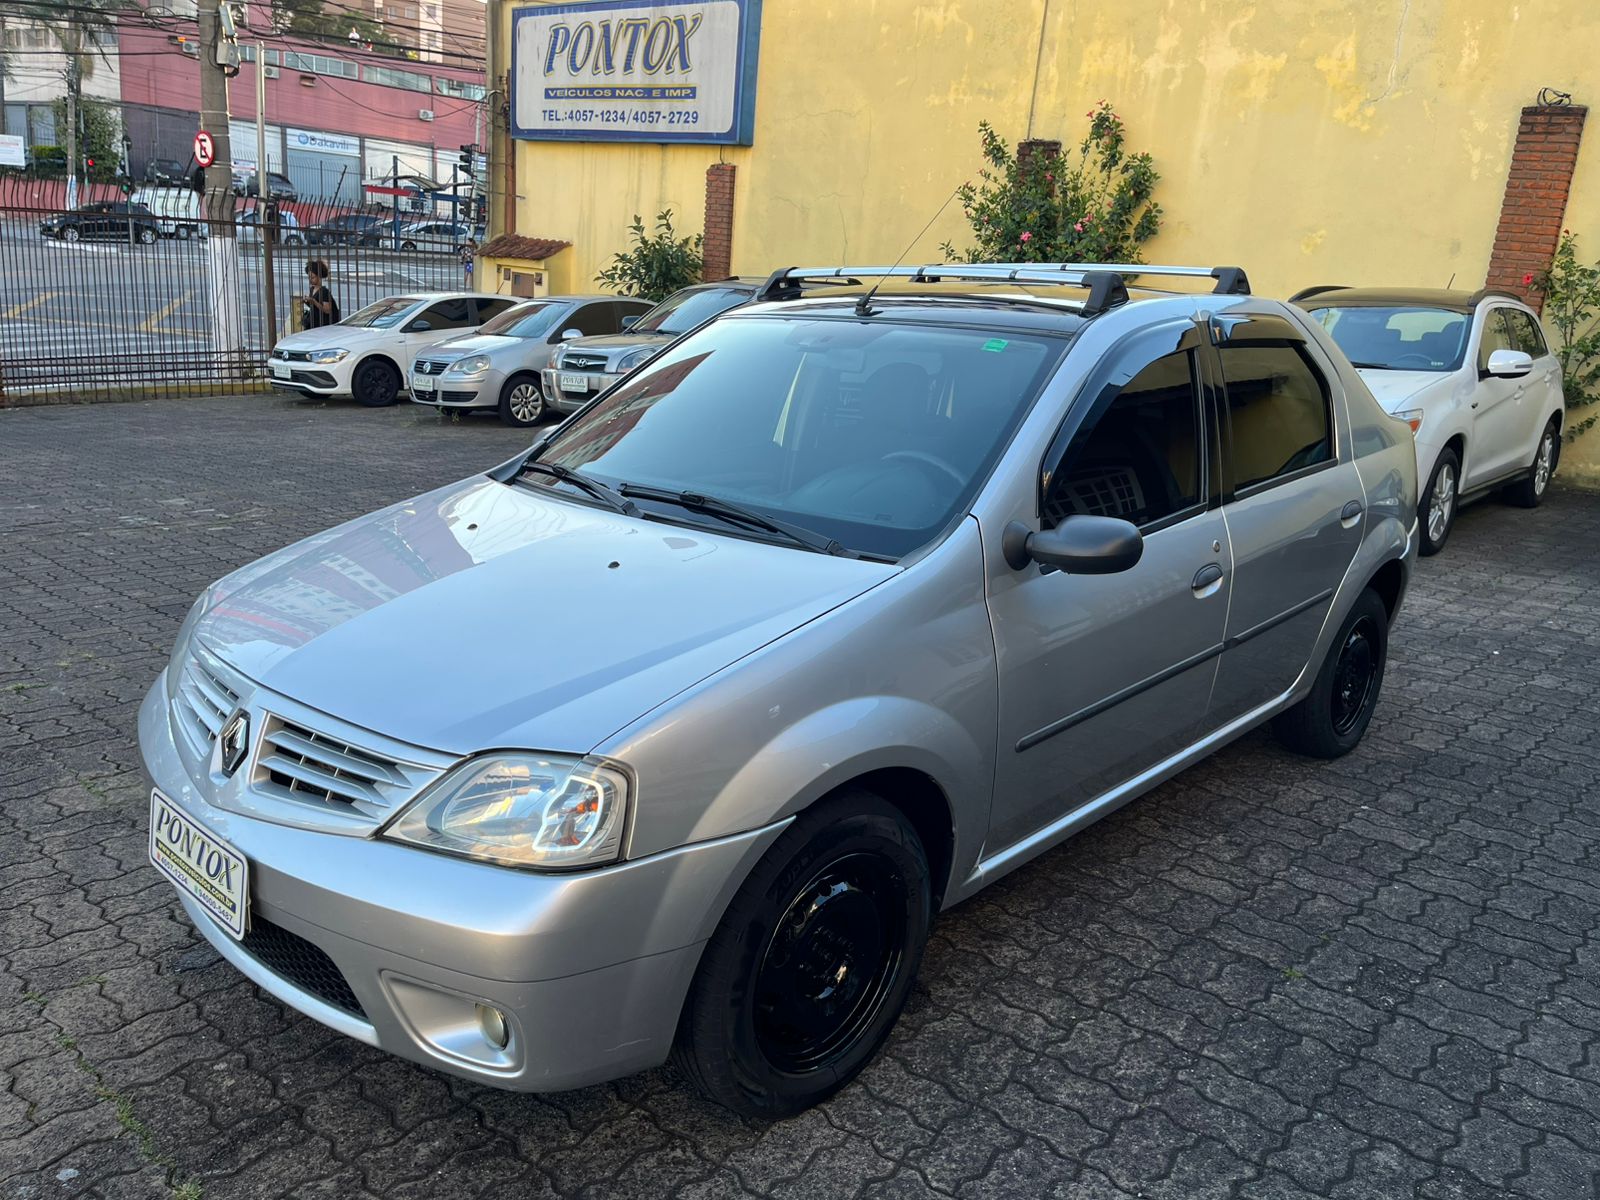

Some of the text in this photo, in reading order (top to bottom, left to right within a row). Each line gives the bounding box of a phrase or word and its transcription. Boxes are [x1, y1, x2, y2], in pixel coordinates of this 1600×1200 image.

[543, 13, 703, 77] PONTOX
[615, 88, 648, 97] NAC.
[652, 89, 661, 97] E
[665, 88, 693, 97] IMP.
[156, 804, 239, 894] PONTOX
